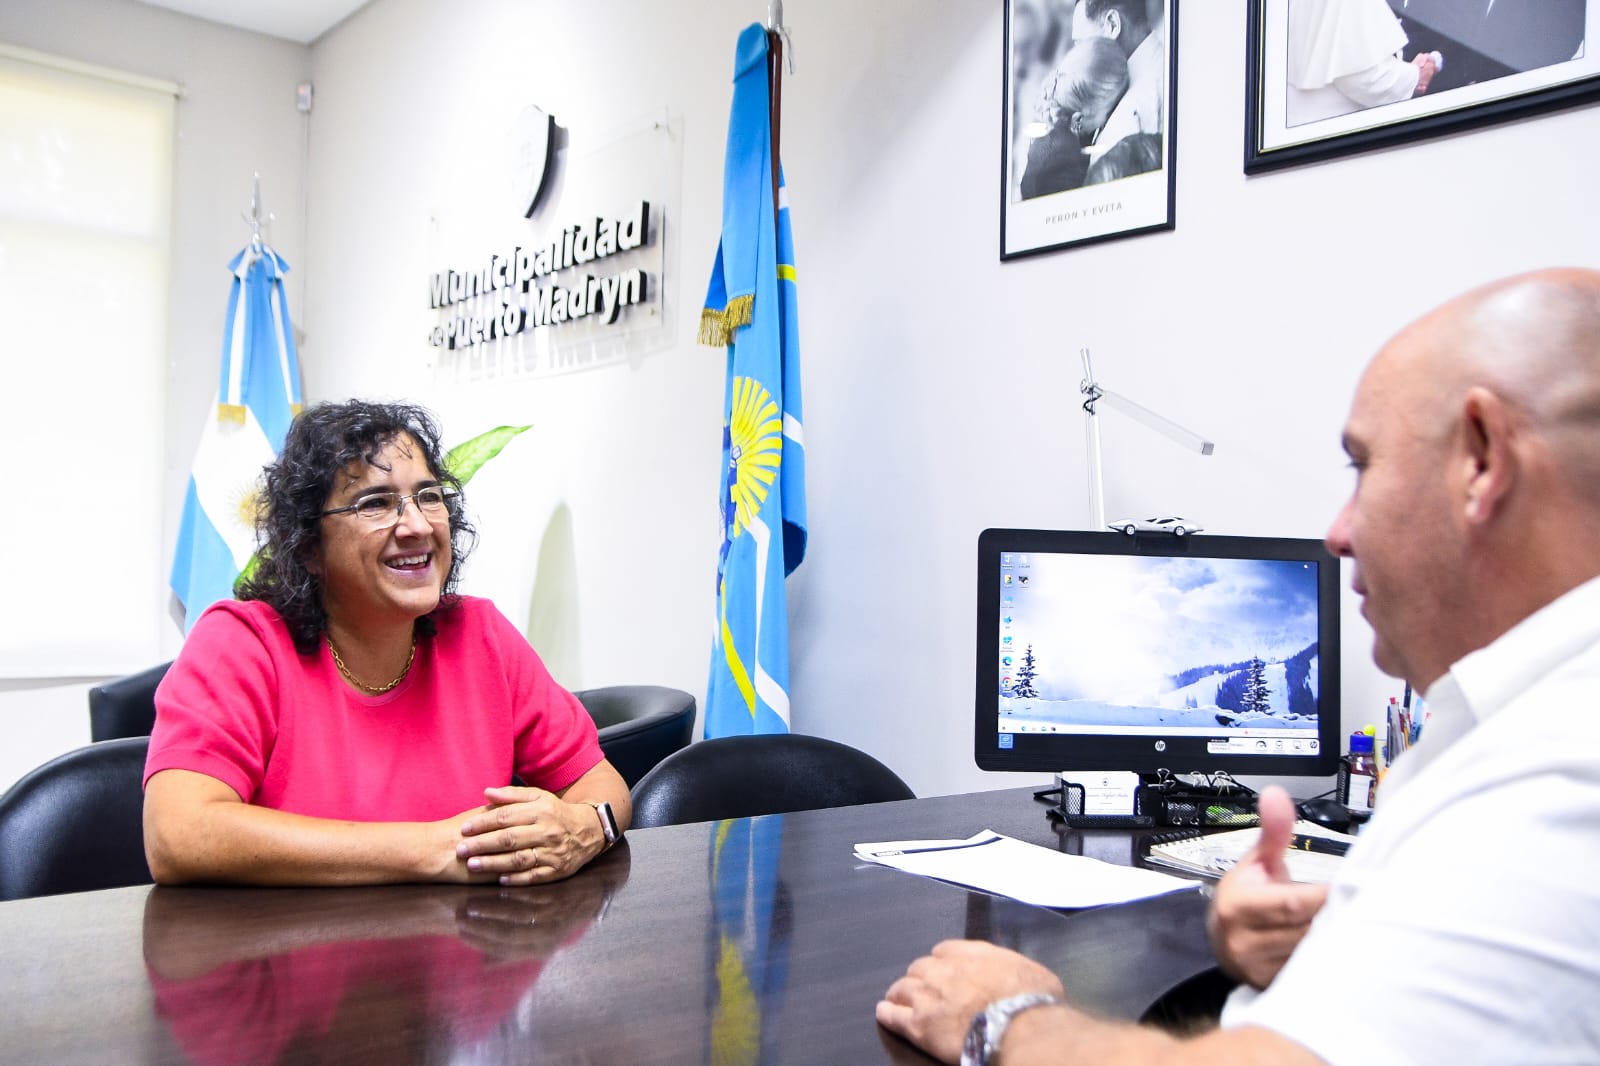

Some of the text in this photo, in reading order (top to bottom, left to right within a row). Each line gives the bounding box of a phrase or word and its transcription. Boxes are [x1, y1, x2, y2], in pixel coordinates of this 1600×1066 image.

[1092, 202, 1122, 216] EVITA
[429, 200, 650, 309] Municipalidad
[445, 296, 526, 351] Puerto
[528, 268, 648, 327] Madryn
